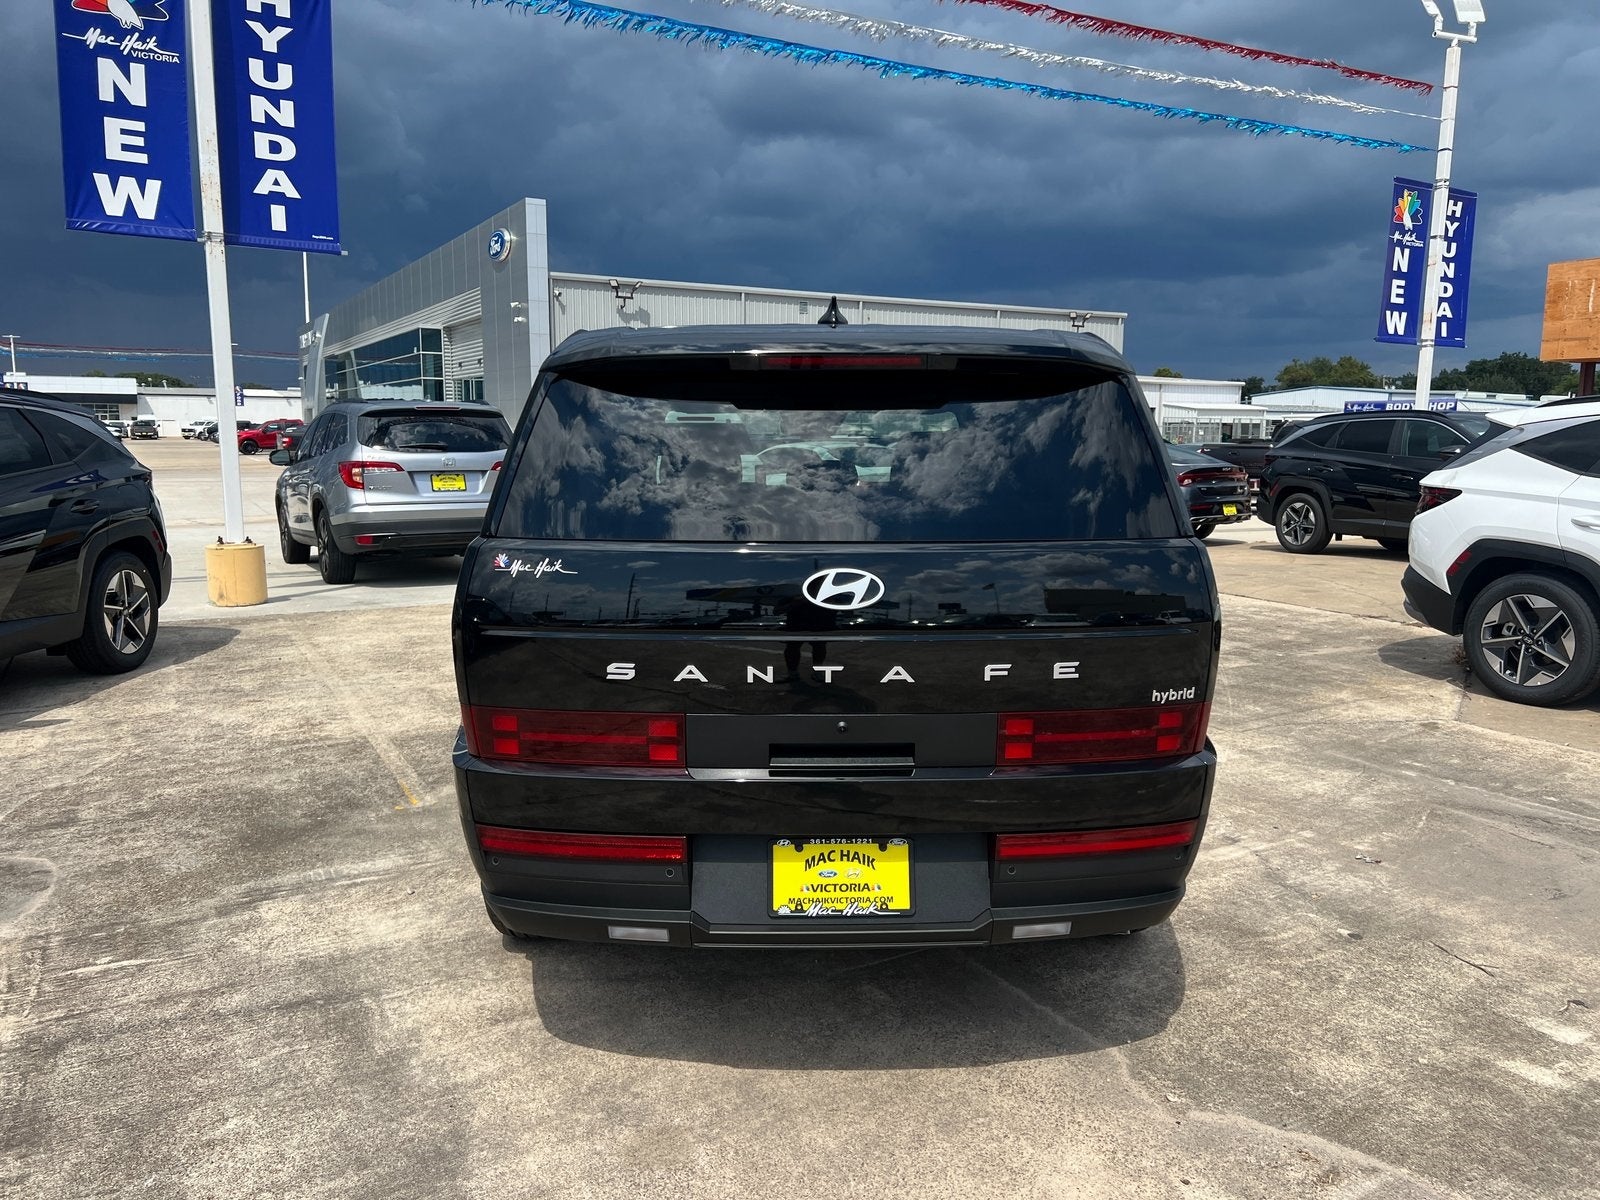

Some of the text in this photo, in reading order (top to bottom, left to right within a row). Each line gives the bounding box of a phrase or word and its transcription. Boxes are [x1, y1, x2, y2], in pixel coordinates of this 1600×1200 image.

[62, 27, 179, 55] Mac Haik
[131, 50, 180, 63] VICTORIA
[93, 57, 162, 220] NEW
[1436, 200, 1463, 337] HYUNDAI
[1385, 247, 1410, 335] NEW
[1428, 401, 1455, 411] HOP
[495, 557, 578, 578] Mac Haik
[606, 661, 1080, 684] SANTA FE
[1152, 687, 1195, 704] hybrid
[804, 849, 876, 871] MAC HAIK
[811, 883, 871, 893] VICTORIA
[788, 896, 894, 904] MACHAIKVICTORIA.COM
[796, 902, 900, 917] Mac Haik
